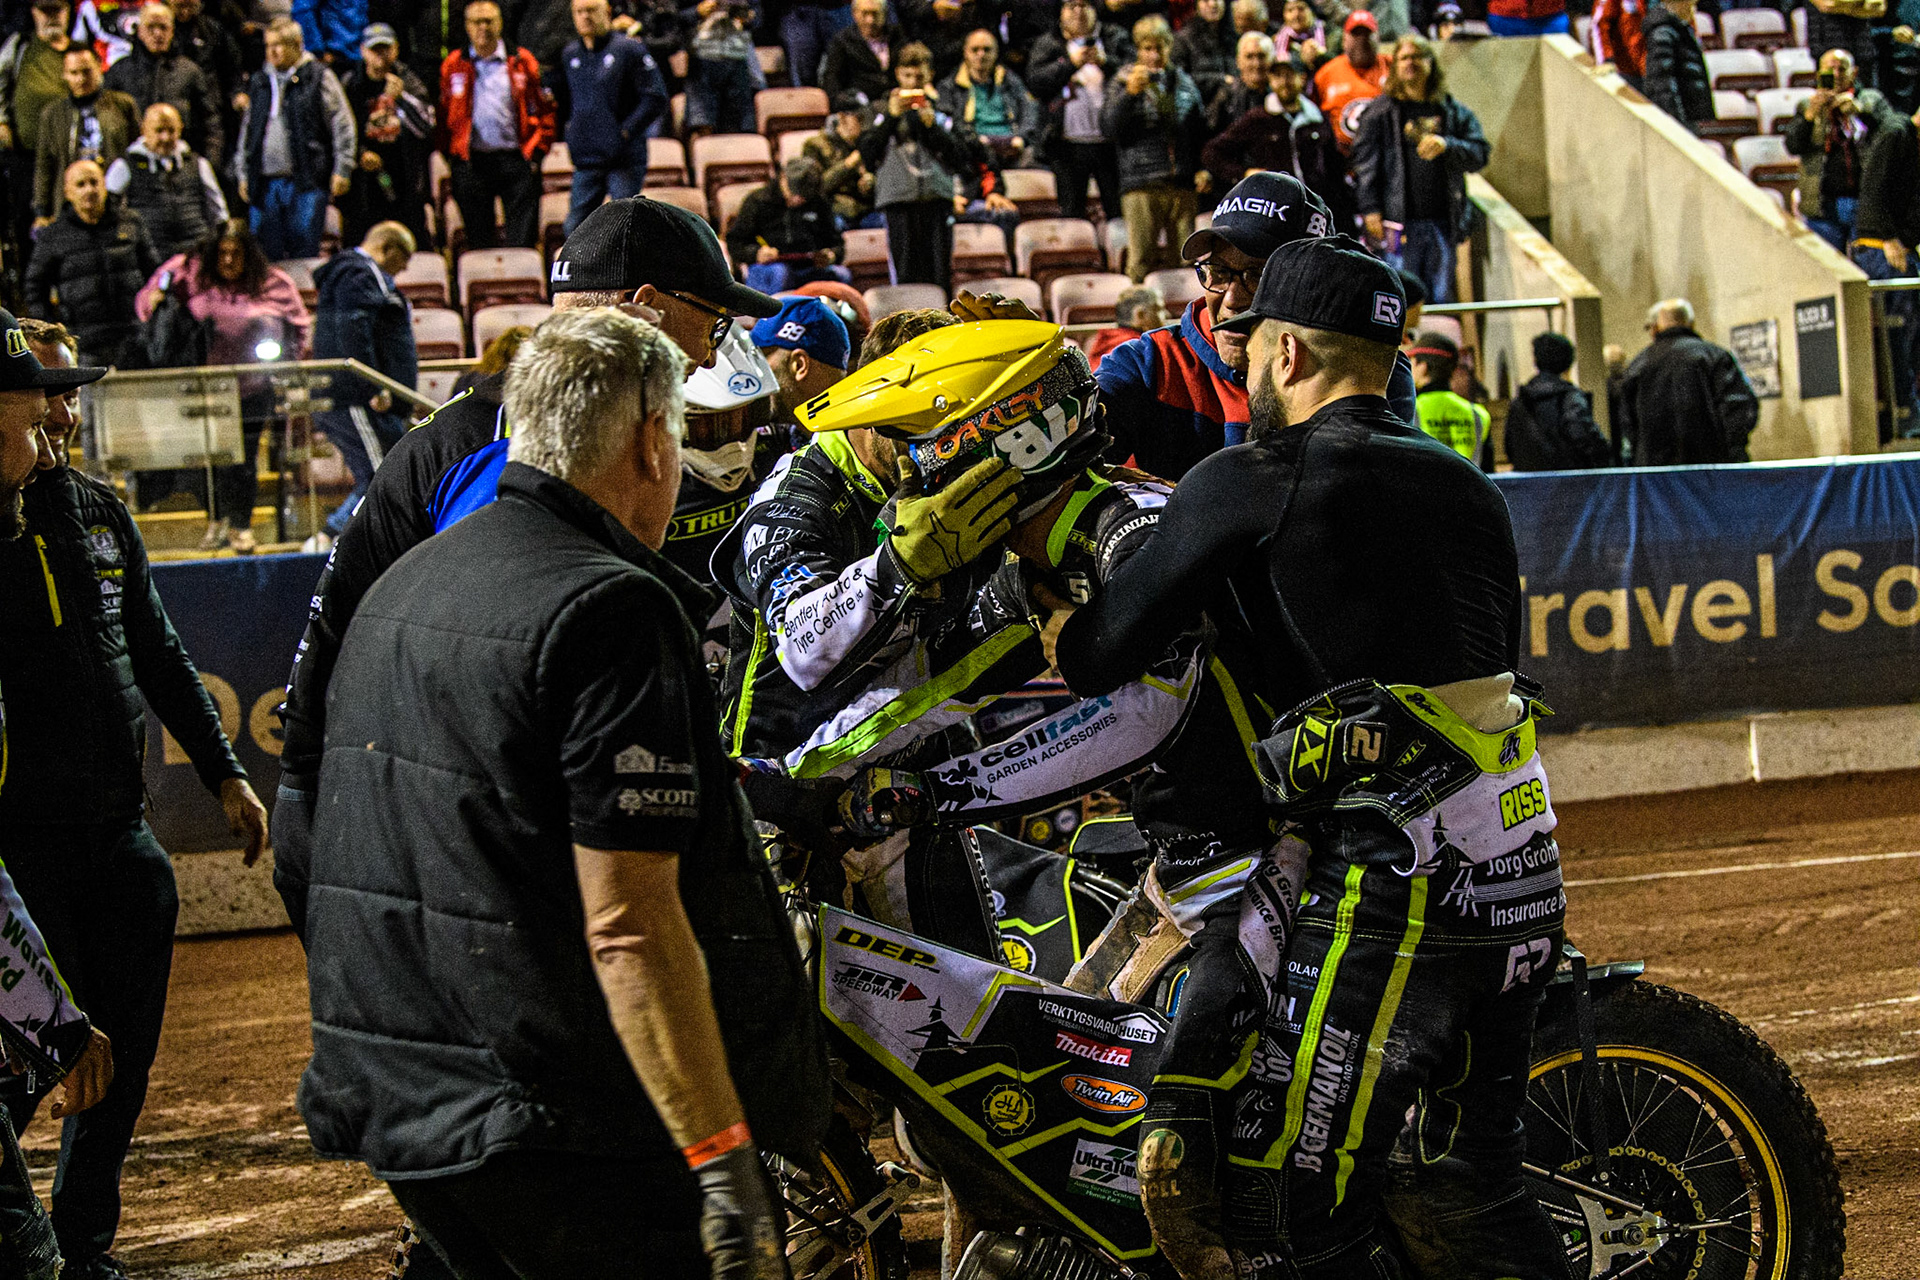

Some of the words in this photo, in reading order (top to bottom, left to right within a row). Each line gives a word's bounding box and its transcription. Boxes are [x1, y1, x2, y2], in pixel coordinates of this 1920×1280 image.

[777, 302, 806, 341] 89
[935, 383, 1043, 459] OAKLEY
[783, 599, 819, 640] Bentley
[852, 567, 863, 581] &
[793, 620, 816, 654] Tyre
[812, 599, 856, 636] Centre
[1519, 553, 1777, 657] ravel
[980, 694, 1112, 767] cellfast
[987, 756, 1038, 783] GARDEN
[1041, 713, 1118, 762] ACCESSORIES
[1499, 778, 1547, 832] RISS
[1490, 895, 1557, 927] Insurance
[832, 925, 937, 967] DEP
[831, 973, 899, 1001] SPEEDWAY
[1038, 999, 1156, 1043] VERKTYGSVARUHUSET
[1074, 1079, 1112, 1100] Twin
[1111, 1090, 1138, 1107] Air
[1299, 1023, 1352, 1153] GERMANOIL
[1337, 1081, 1350, 1103] DAS
[1075, 1149, 1138, 1179] UltraTun
